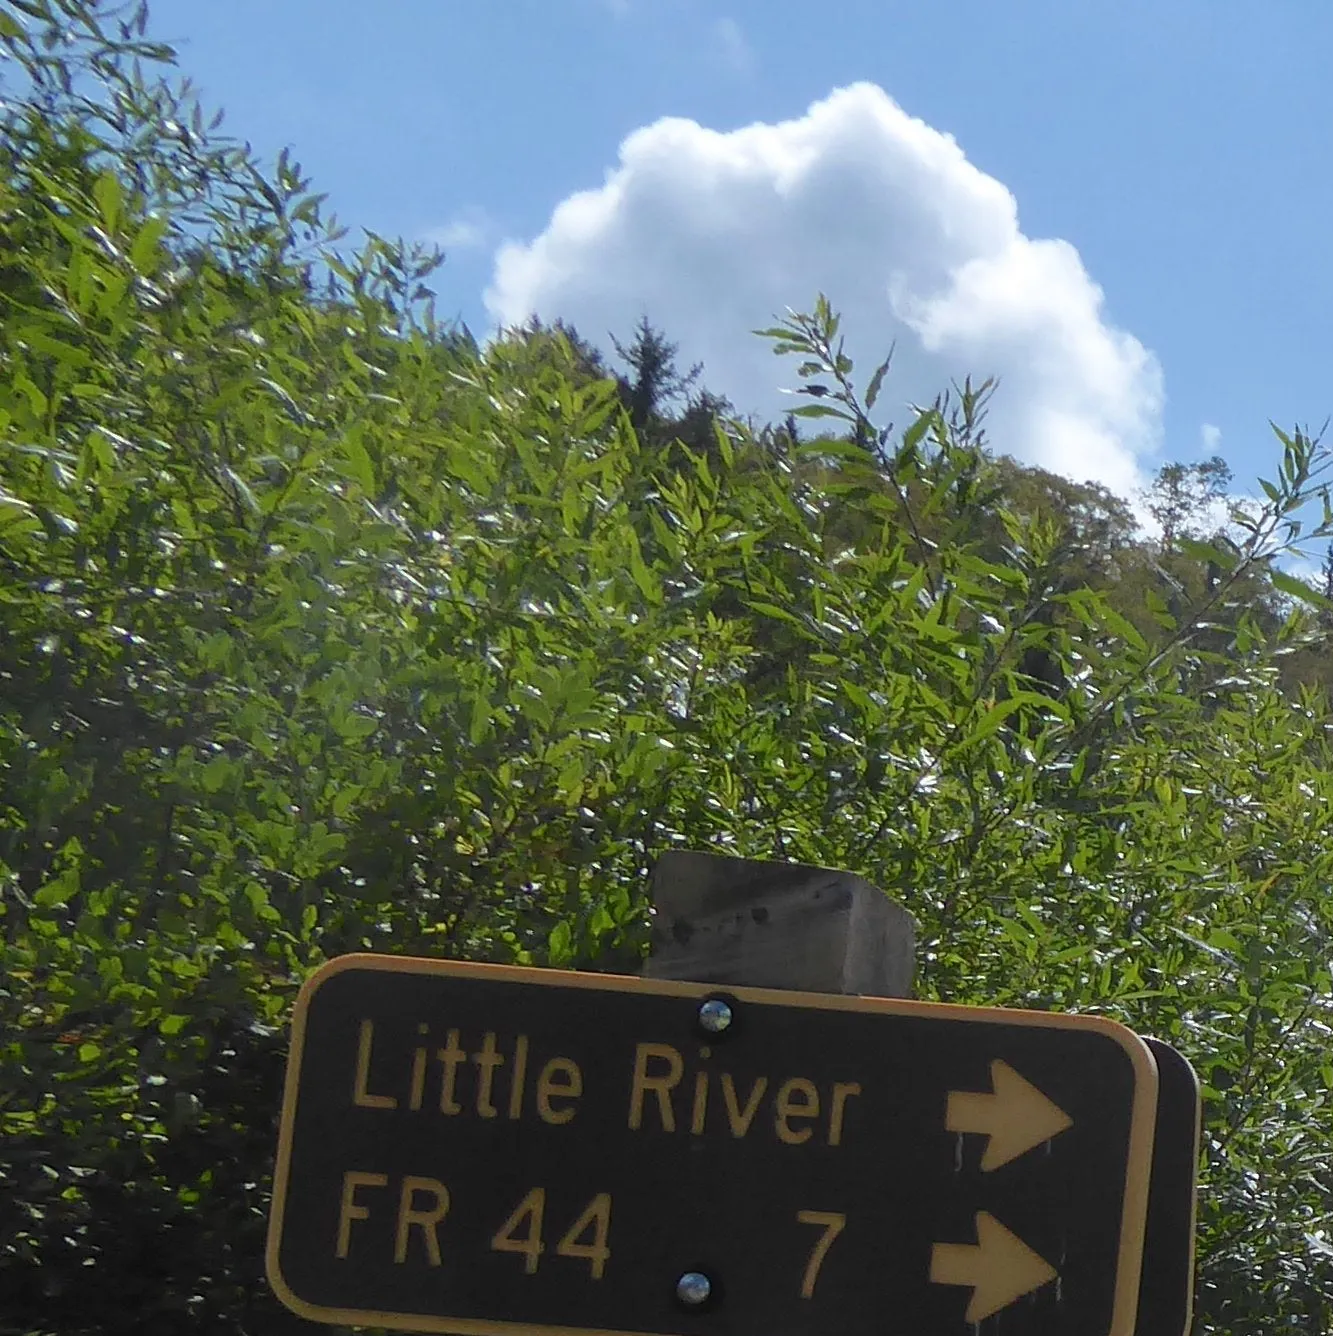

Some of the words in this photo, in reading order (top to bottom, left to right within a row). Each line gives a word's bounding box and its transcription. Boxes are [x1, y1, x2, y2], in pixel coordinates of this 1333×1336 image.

[354, 1021, 583, 1124] Little
[628, 1042, 861, 1146] River
[335, 1171, 450, 1267] FR
[491, 1187, 612, 1280] 44
[796, 1210, 846, 1299] 7
